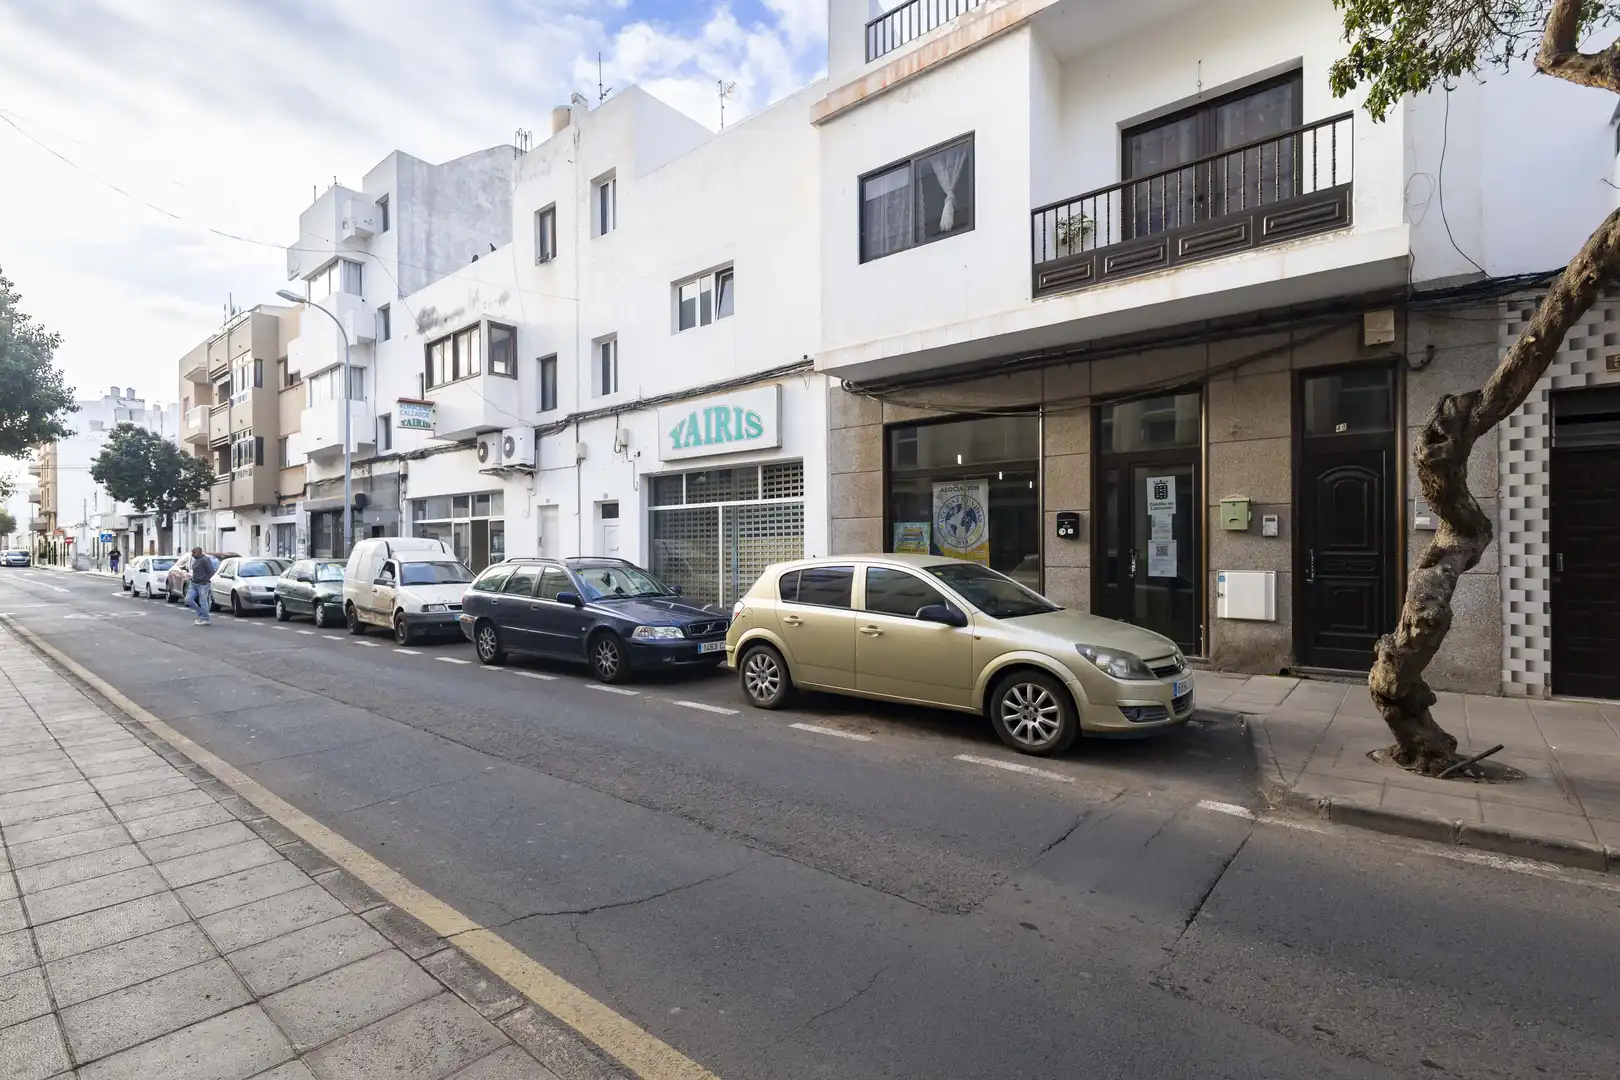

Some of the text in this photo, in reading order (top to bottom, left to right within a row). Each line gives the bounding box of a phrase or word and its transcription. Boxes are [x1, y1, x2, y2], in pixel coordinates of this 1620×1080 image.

[400, 409, 430, 418] CALZADOS
[400, 418, 431, 428] YAIRIS
[669, 405, 764, 449] YAIRIS
